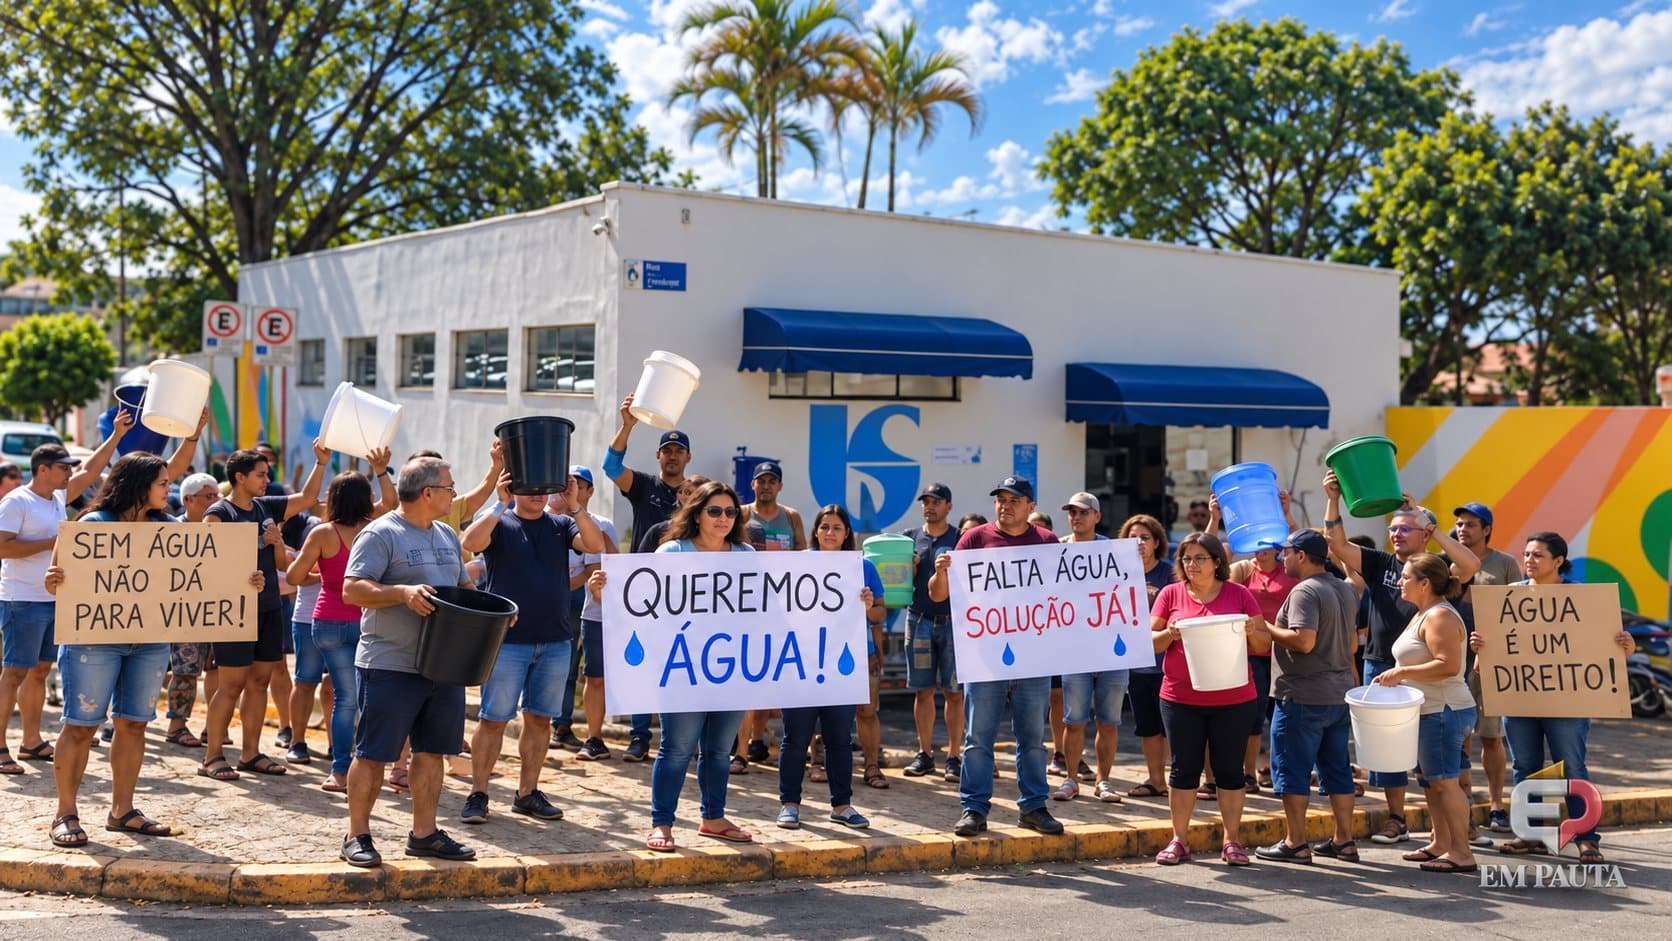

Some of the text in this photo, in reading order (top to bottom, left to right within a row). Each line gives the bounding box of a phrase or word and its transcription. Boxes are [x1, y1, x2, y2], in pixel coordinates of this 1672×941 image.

[218, 312, 230, 330] E
[269, 318, 282, 336] E
[73, 526, 217, 560] SEM ÁGUA
[94, 561, 203, 594] NÃO DÁ
[967, 547, 1129, 593] FALTA ÁGUA,
[623, 567, 844, 620] QUEREMOS
[966, 583, 1140, 639] SOLUÇÃO JÁ!
[1499, 589, 1581, 625] ÁGUA
[75, 602, 144, 631] PARA
[658, 620, 827, 688] ÁGUA!
[1505, 627, 1570, 656] É UM
[1493, 657, 1618, 694] DIREITO!
